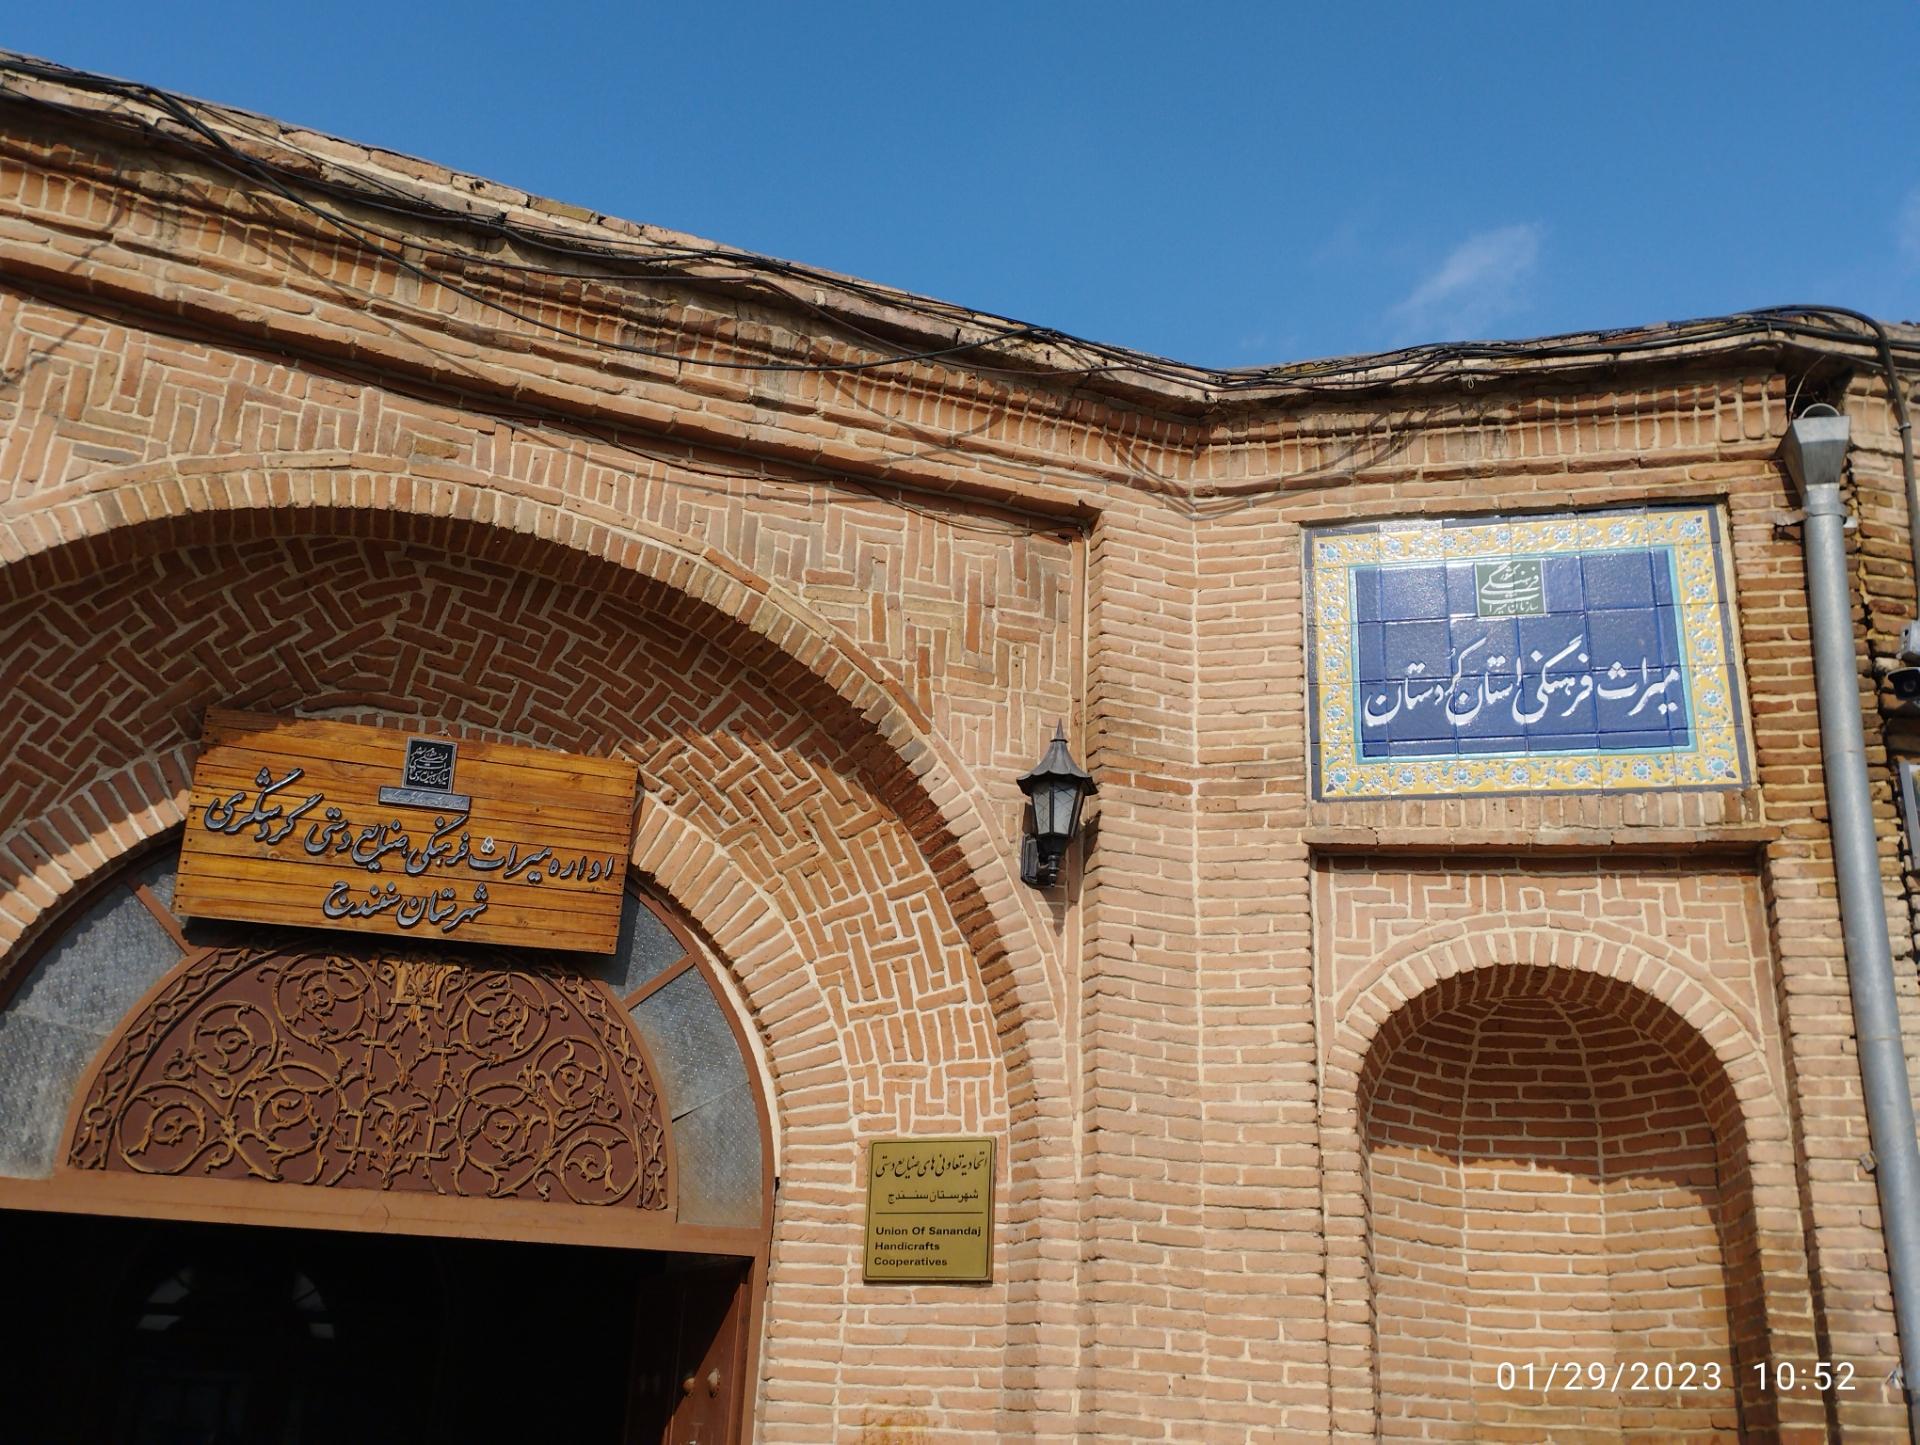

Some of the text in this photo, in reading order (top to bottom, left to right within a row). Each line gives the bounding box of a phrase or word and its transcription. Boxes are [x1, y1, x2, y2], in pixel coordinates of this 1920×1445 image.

[1446, 653, 1522, 726] استان
[1512, 634, 1593, 725] فرهنگی
[1597, 656, 1680, 717] میراث
[204, 767, 325, 845] گردشگری
[304, 807, 352, 855] دستی
[352, 819, 409, 872] صنایع
[468, 836, 552, 883] میراث
[549, 856, 614, 882] اداره
[323, 880, 489, 933] شهرستان سنندج
[875, 1156, 895, 1177] دستی
[894, 1155, 920, 1179] صنایع
[935, 1154, 964, 1177] تعاونی
[961, 1151, 988, 1176] اتحادیه
[887, 1189, 979, 1204] شهرستان سنندج
[875, 1226, 982, 1237] Union Of Sanandaj
[875, 1241, 941, 1251] Handicrafts
[874, 1256, 948, 1267] Cooperatives
